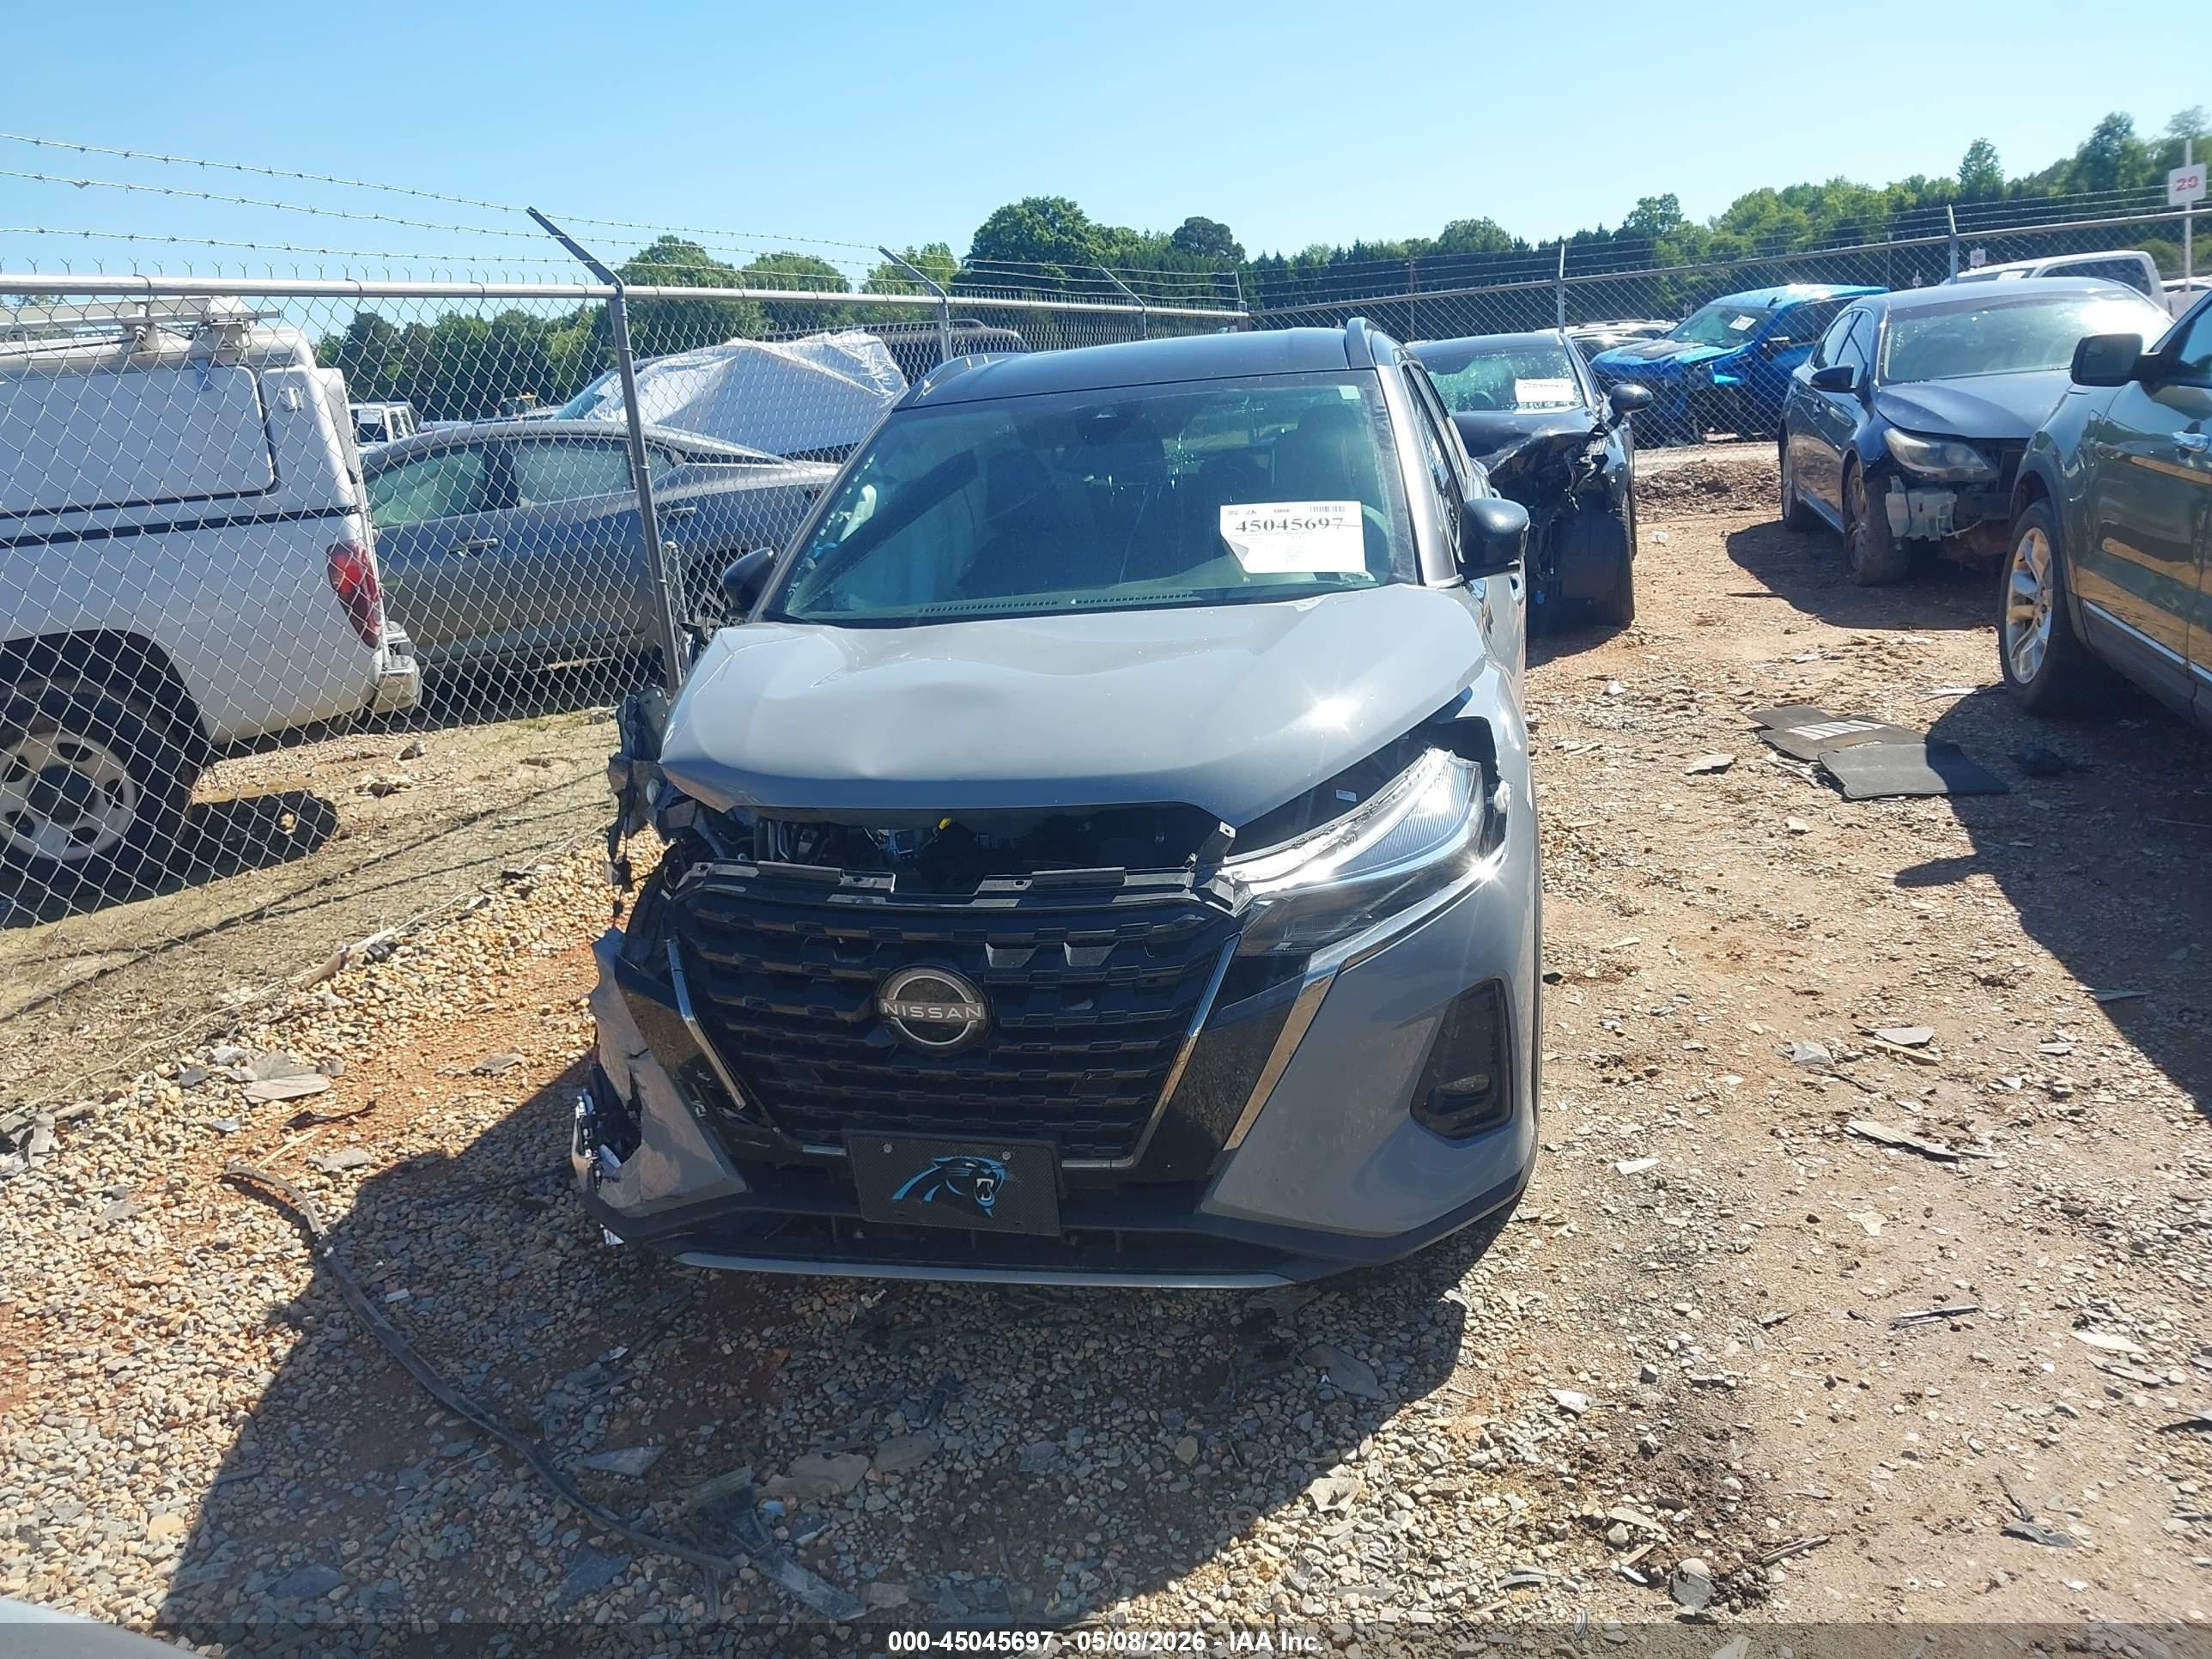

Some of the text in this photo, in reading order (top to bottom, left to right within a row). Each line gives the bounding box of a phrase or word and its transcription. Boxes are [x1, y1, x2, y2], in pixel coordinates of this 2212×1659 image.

[2176, 175, 2198, 191] 20
[1235, 517, 1344, 532] 45045697
[883, 1002, 981, 1019] NISSAN
